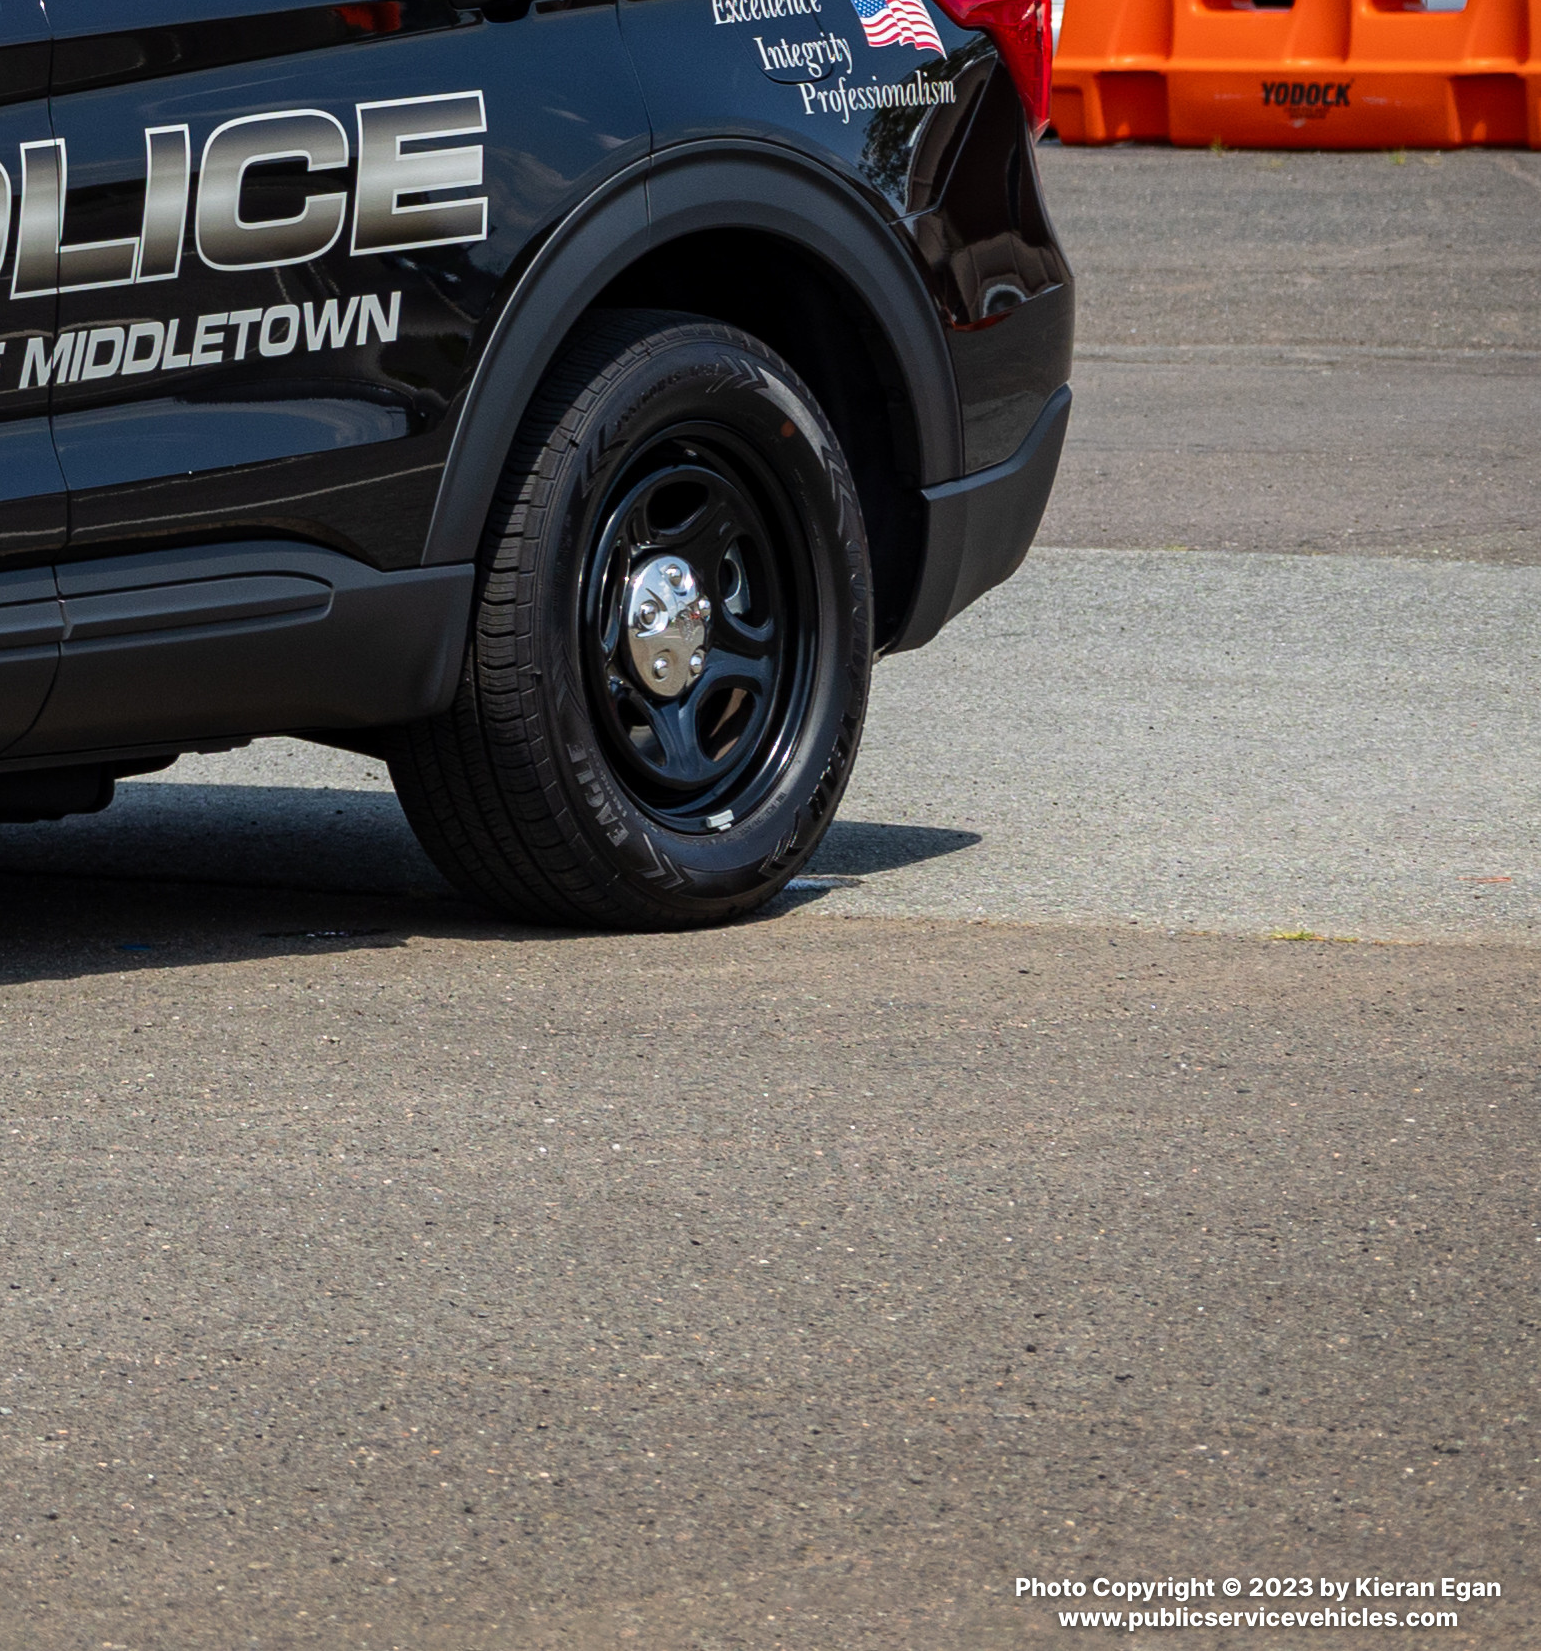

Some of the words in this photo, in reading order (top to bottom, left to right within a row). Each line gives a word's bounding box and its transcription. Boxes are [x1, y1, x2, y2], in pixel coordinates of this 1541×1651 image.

[752, 32, 853, 78] Integrity
[798, 70, 957, 124] Professionalism
[1262, 81, 1350, 107] YODOCK
[19, 291, 402, 386] MIDDLETOWN
[566, 740, 631, 848] EAGLE
